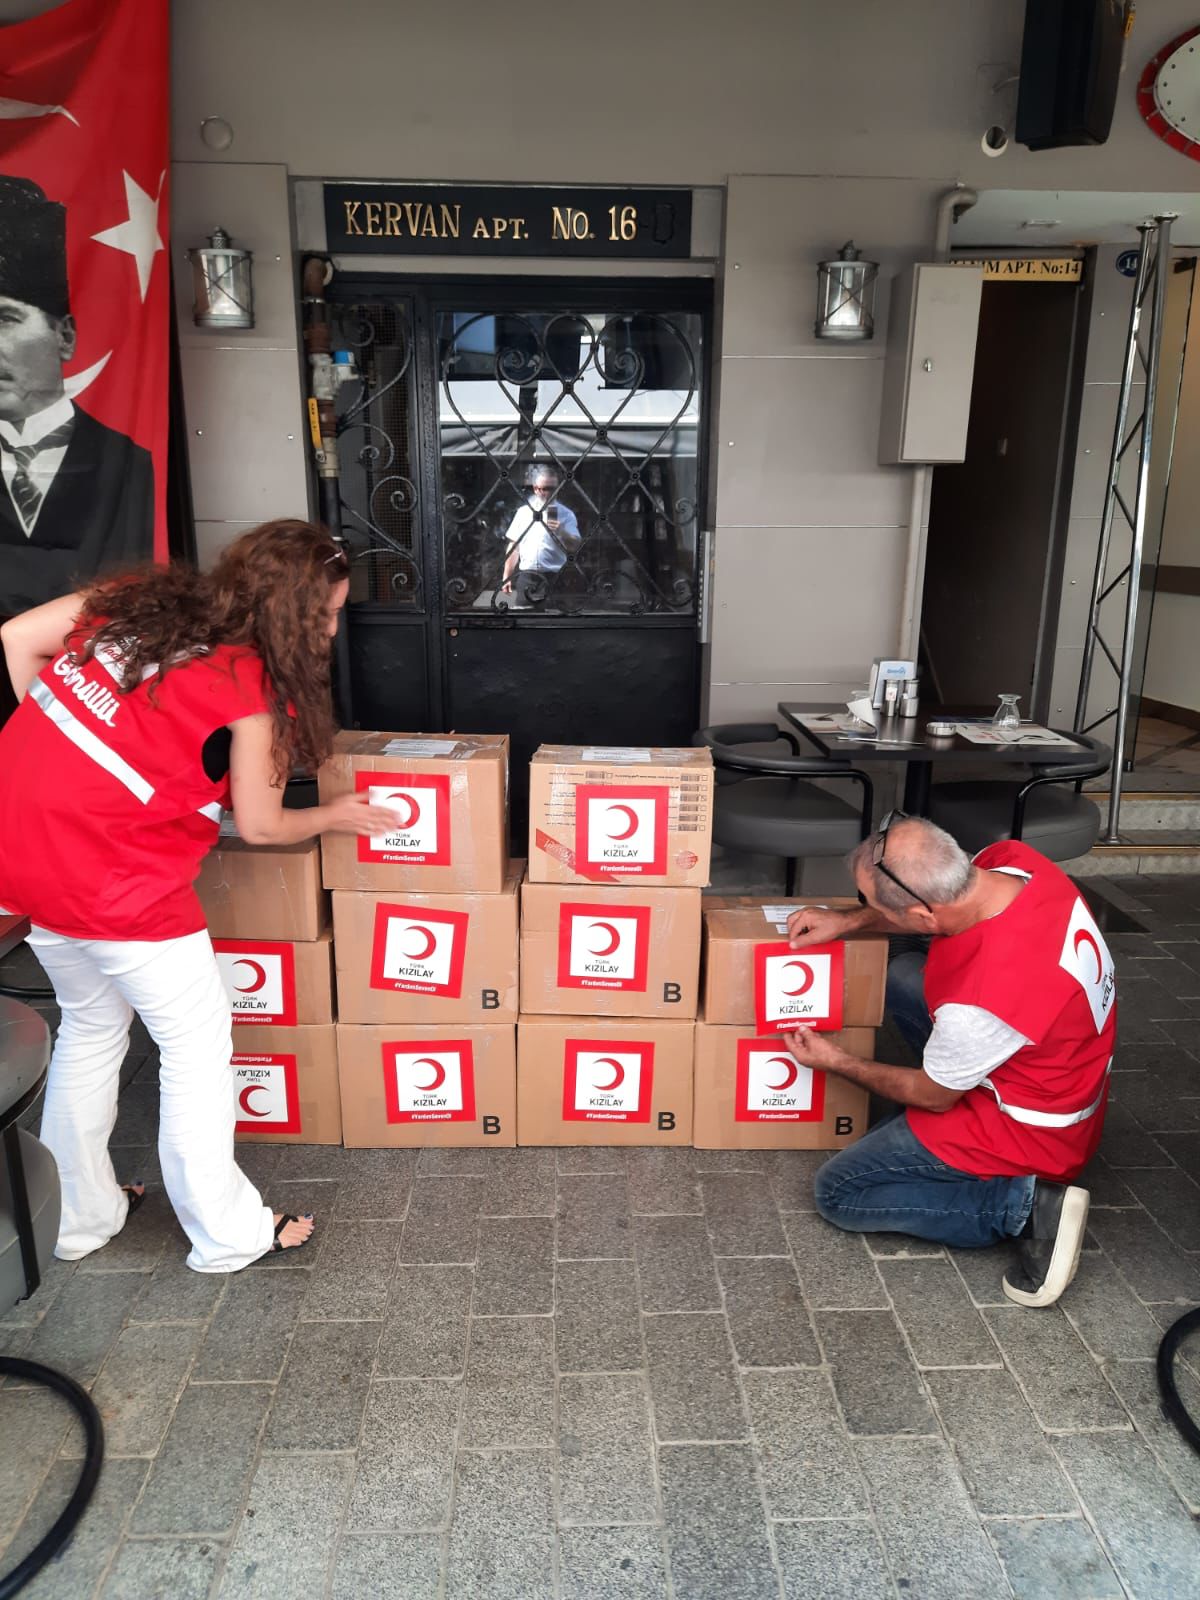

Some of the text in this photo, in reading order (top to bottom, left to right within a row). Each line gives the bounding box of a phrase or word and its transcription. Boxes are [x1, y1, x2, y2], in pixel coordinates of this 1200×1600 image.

[344, 201, 461, 238] KERVAN
[472, 216, 529, 240] APT.
[608, 205, 637, 242] 16
[1003, 260, 1036, 273] APT.
[1040, 259, 1080, 274] No:14
[385, 838, 421, 847] KIZILAY
[603, 849, 639, 858] KIZILAY
[399, 967, 434, 978] KIZILAY
[585, 964, 619, 973] KIZILAY
[663, 982, 682, 1003] B
[481, 989, 500, 1010] B
[232, 1001, 267, 1009] KIZILAY
[779, 1005, 813, 1014] KIZILAY
[236, 1069, 271, 1077] KIZILAY
[413, 1099, 447, 1107] KIZILAY
[589, 1098, 623, 1106] KIZILAY
[762, 1098, 797, 1106] KIZILAY
[482, 1115, 501, 1135] B
[658, 1111, 676, 1131] B
[835, 1116, 853, 1135] B
